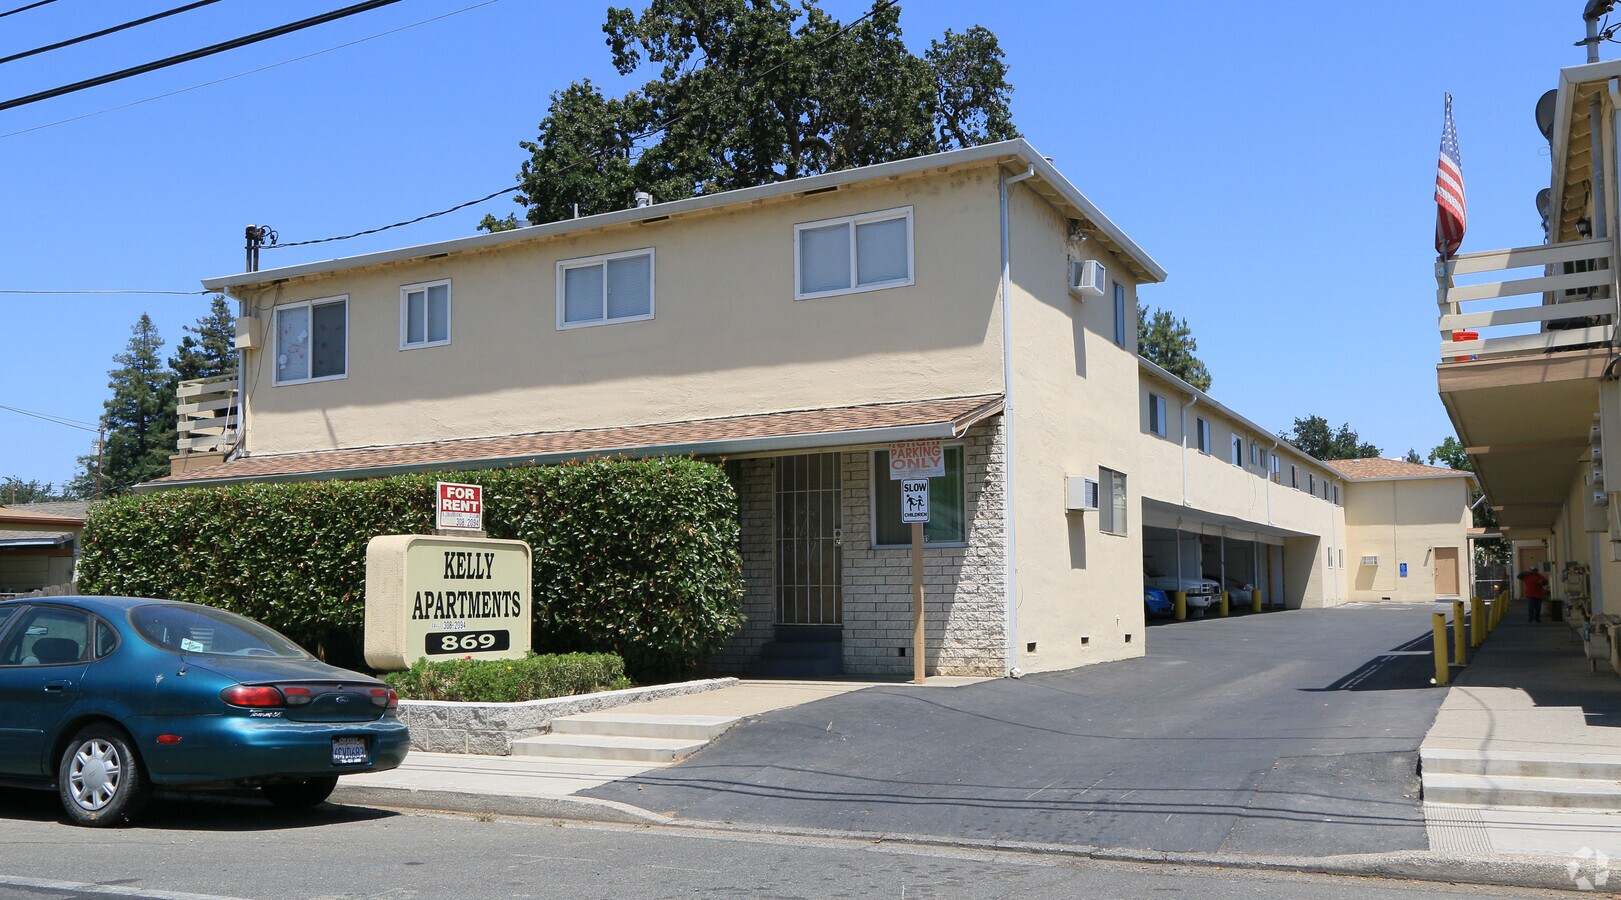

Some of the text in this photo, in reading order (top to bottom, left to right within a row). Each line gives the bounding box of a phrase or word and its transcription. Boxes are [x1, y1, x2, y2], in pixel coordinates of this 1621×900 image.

[891, 445, 942, 459] PARKING
[891, 457, 942, 470] ONLY
[446, 486, 475, 500] FOR
[904, 483, 927, 492] SLOW
[442, 498, 479, 512] RENT
[443, 551, 495, 579] KELLY
[412, 590, 521, 620] APARTMENTS
[441, 633, 496, 651] 869
